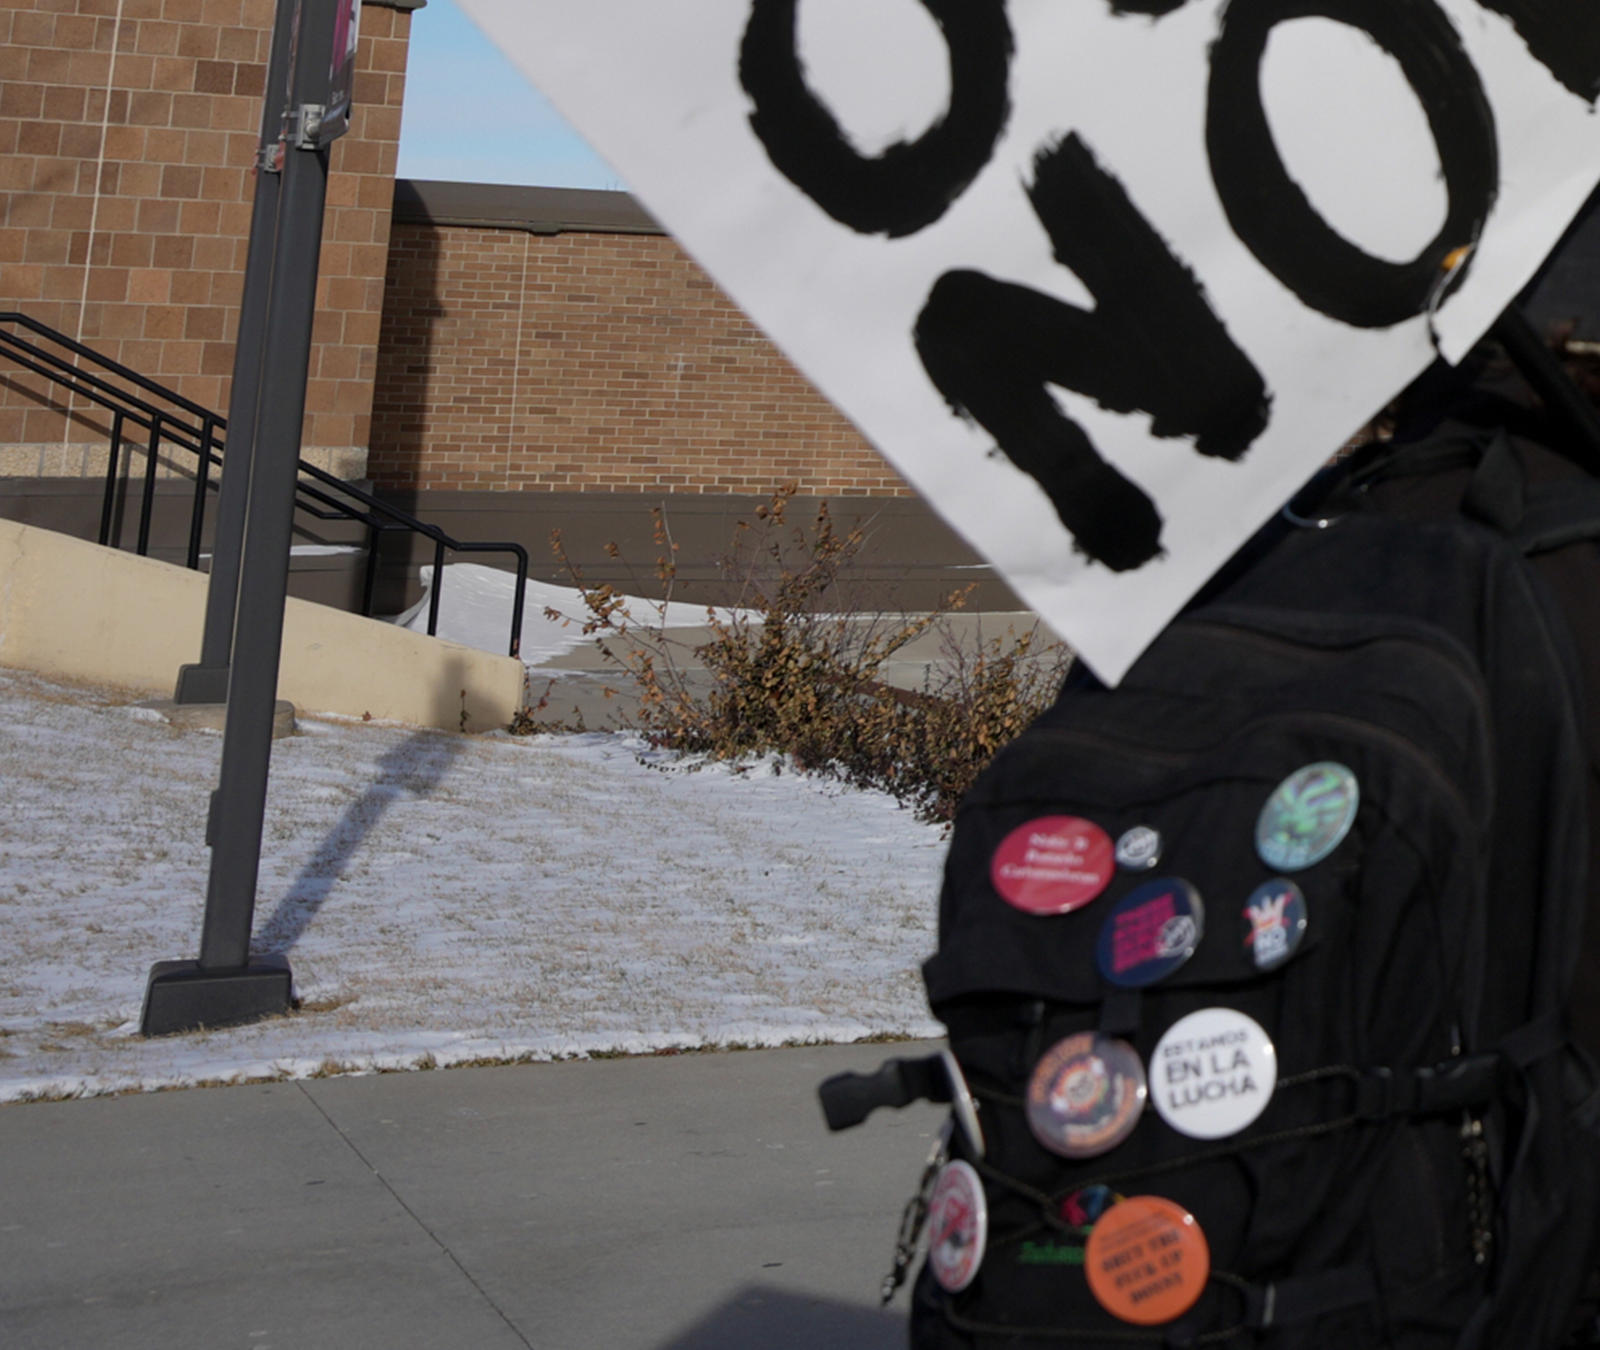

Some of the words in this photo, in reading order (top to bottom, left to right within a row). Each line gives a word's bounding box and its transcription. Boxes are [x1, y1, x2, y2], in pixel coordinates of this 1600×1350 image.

[1163, 1031, 1248, 1058] ESTAMOS
[1166, 1054, 1201, 1084] EN
[1211, 1048, 1251, 1074] LA
[1169, 1074, 1258, 1109] LUCHA
